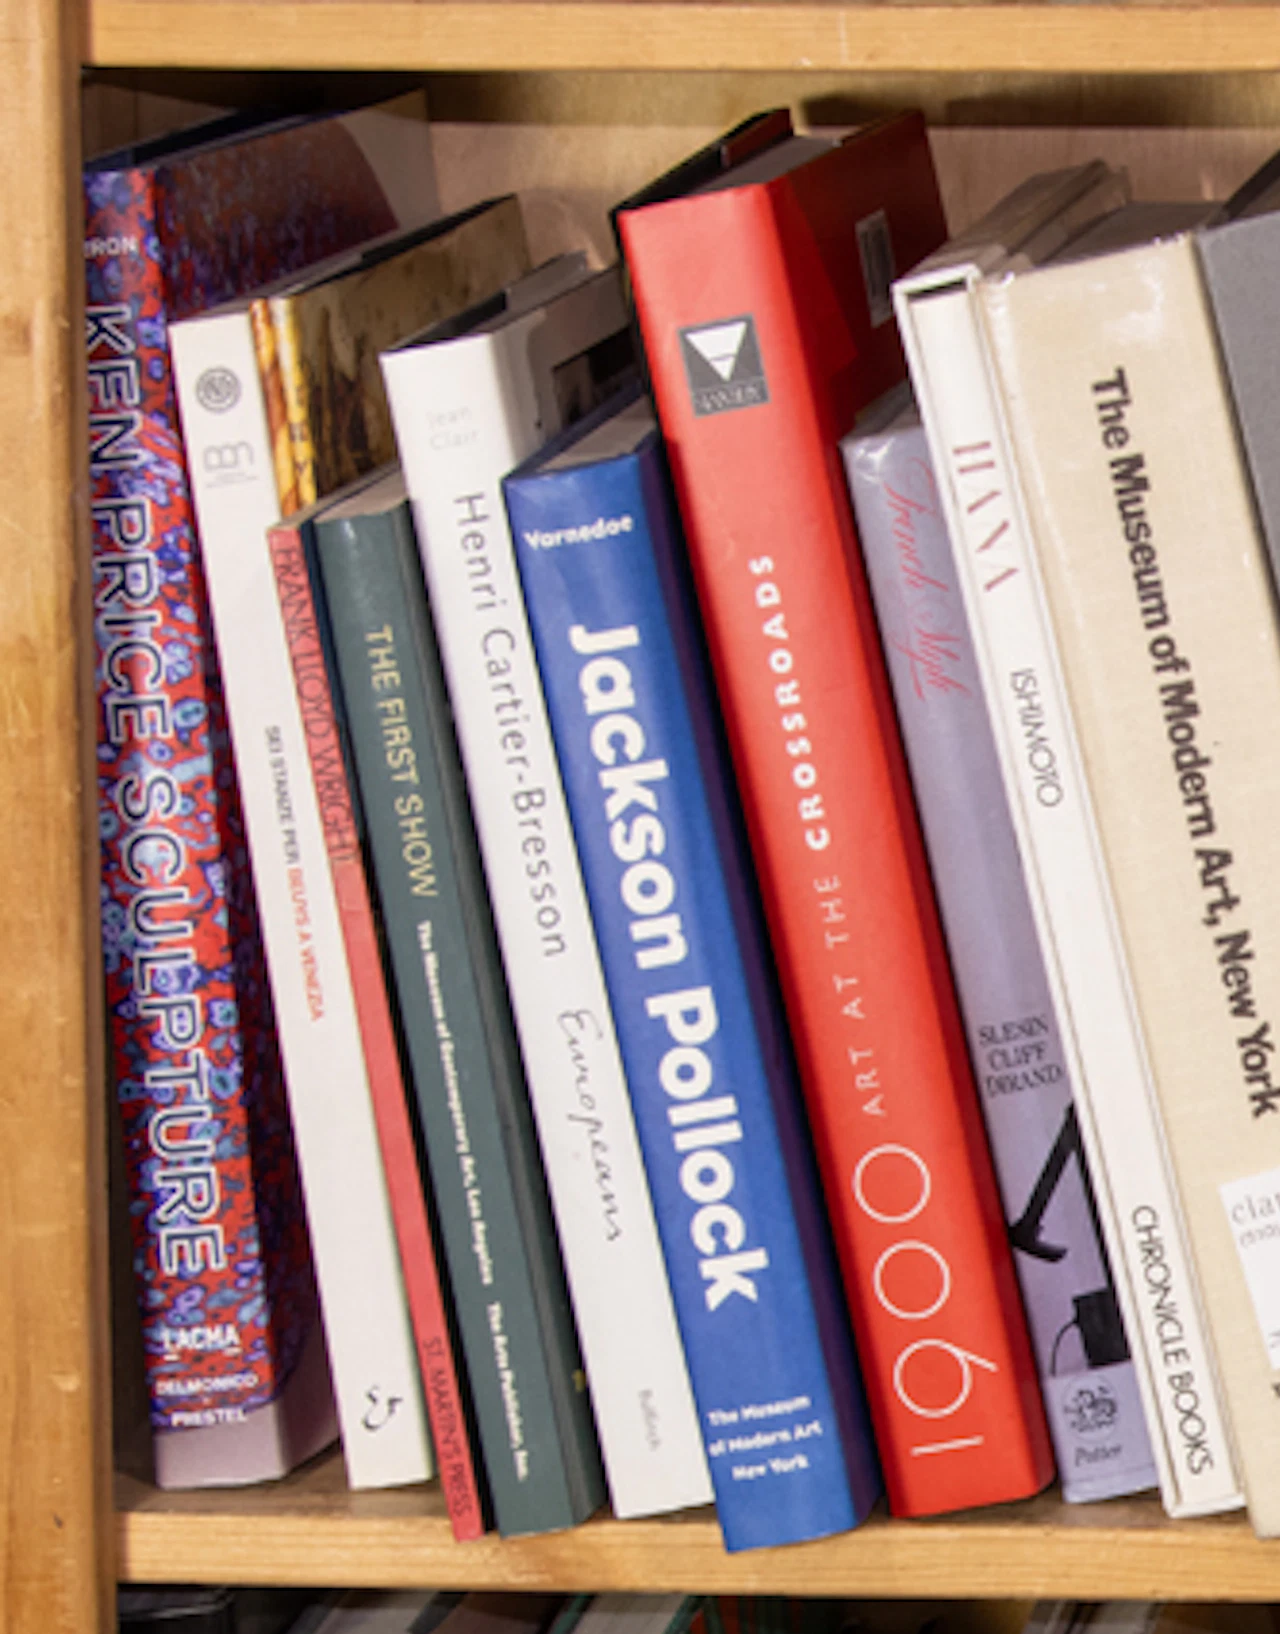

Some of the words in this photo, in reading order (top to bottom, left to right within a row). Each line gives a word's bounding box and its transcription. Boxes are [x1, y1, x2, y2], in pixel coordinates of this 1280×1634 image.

[85, 304, 142, 468] KEN
[1093, 367, 1133, 450] The
[455, 491, 506, 609] Henri
[523, 514, 634, 550] Varnedoe
[1110, 453, 1170, 629] Museum
[90, 499, 171, 743] PRICE
[271, 546, 313, 642] FRANK
[290, 650, 331, 738] LLOYD
[365, 624, 402, 691] THE
[1149, 630, 1191, 676] of
[264, 724, 281, 752] SEI
[377, 697, 419, 787] FIRST
[748, 556, 832, 850] CROSSROADS
[1011, 668, 1063, 807] ISHIMOTO
[480, 630, 566, 958] Cartier-Bresson
[1159, 678, 1217, 839] Modern
[281, 816, 300, 865] PER
[311, 745, 354, 862] WRIGHT
[395, 791, 437, 896] SHOW
[299, 923, 313, 940] A
[813, 875, 849, 949] THE
[1194, 847, 1240, 928] Art,
[300, 943, 326, 1024] VENEZIA
[569, 624, 688, 970] Jackson
[645, 985, 769, 1311] Pollock
[835, 974, 865, 1020] AT
[1214, 930, 1257, 1019] New
[114, 772, 227, 1276] SCULPTURE
[557, 1006, 622, 1241] Europeans
[849, 1047, 887, 1117] ART
[161, 1325, 240, 1358] LACMA
[852, 1143, 998, 1456] 1900
[1132, 1205, 1190, 1369] CHRONICLE
[1167, 1372, 1215, 1477] BOOKS
[156, 1371, 257, 1396] DELMONICO
[170, 1408, 247, 1427] PRESTEL
[708, 1405, 738, 1427] The
[740, 1395, 811, 1421] Museum
[708, 1437, 727, 1457] of
[729, 1426, 792, 1454] Modern
[793, 1421, 824, 1444] Art
[731, 1460, 767, 1482] New
[768, 1453, 810, 1475] York
